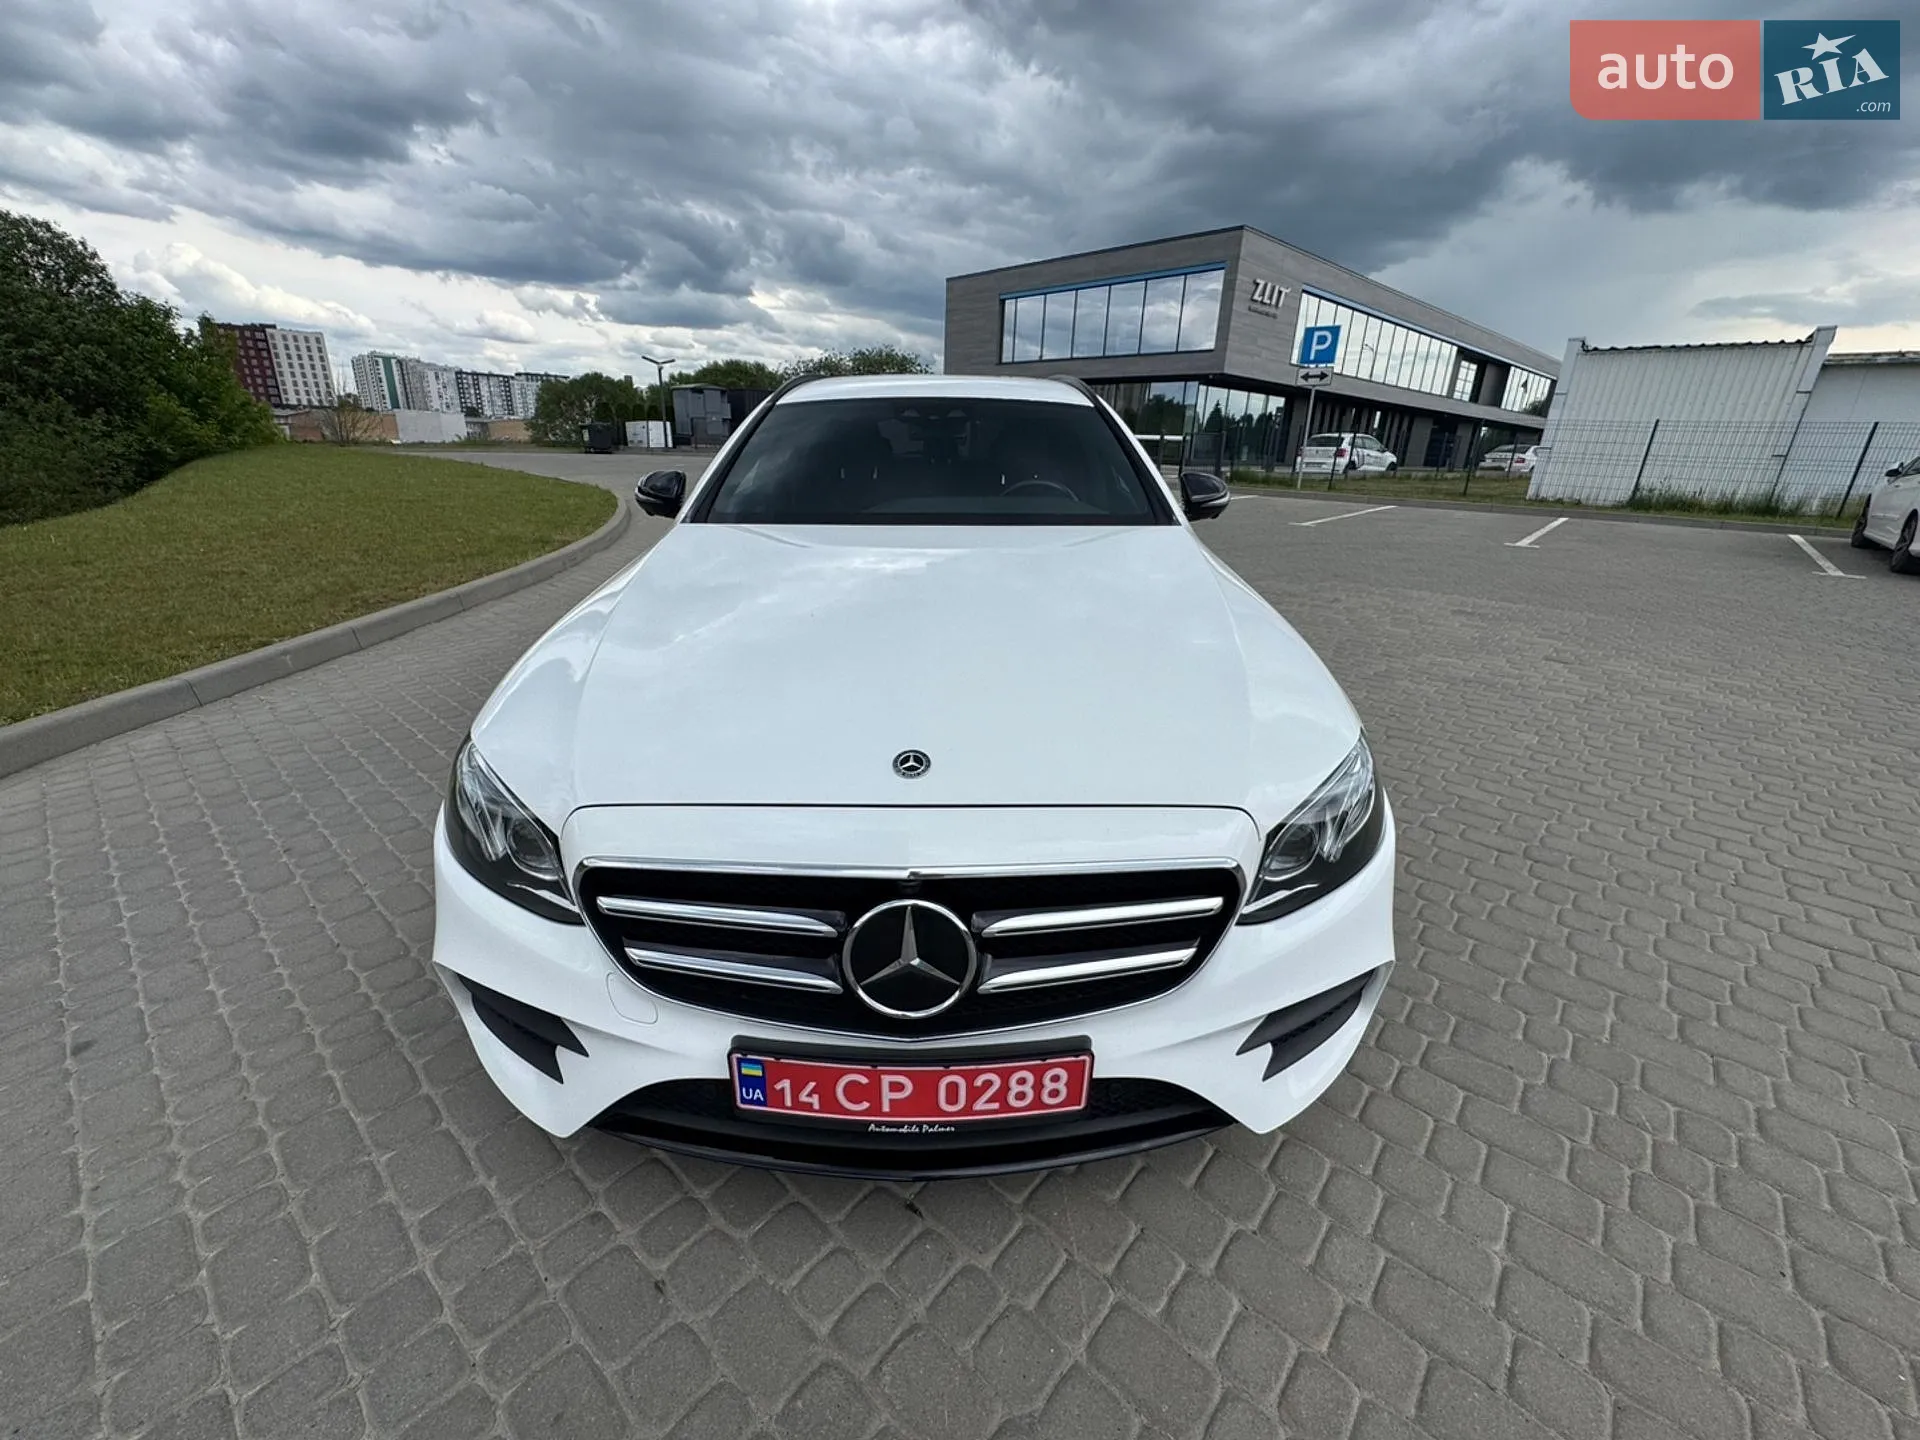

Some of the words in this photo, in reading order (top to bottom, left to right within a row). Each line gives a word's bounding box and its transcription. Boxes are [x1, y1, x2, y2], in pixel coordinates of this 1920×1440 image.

[1309, 330, 1332, 361] P
[742, 1088, 765, 1102] UA
[774, 1079, 820, 1110] 14
[835, 1073, 914, 1112] CP
[937, 1067, 1069, 1113] 0288
